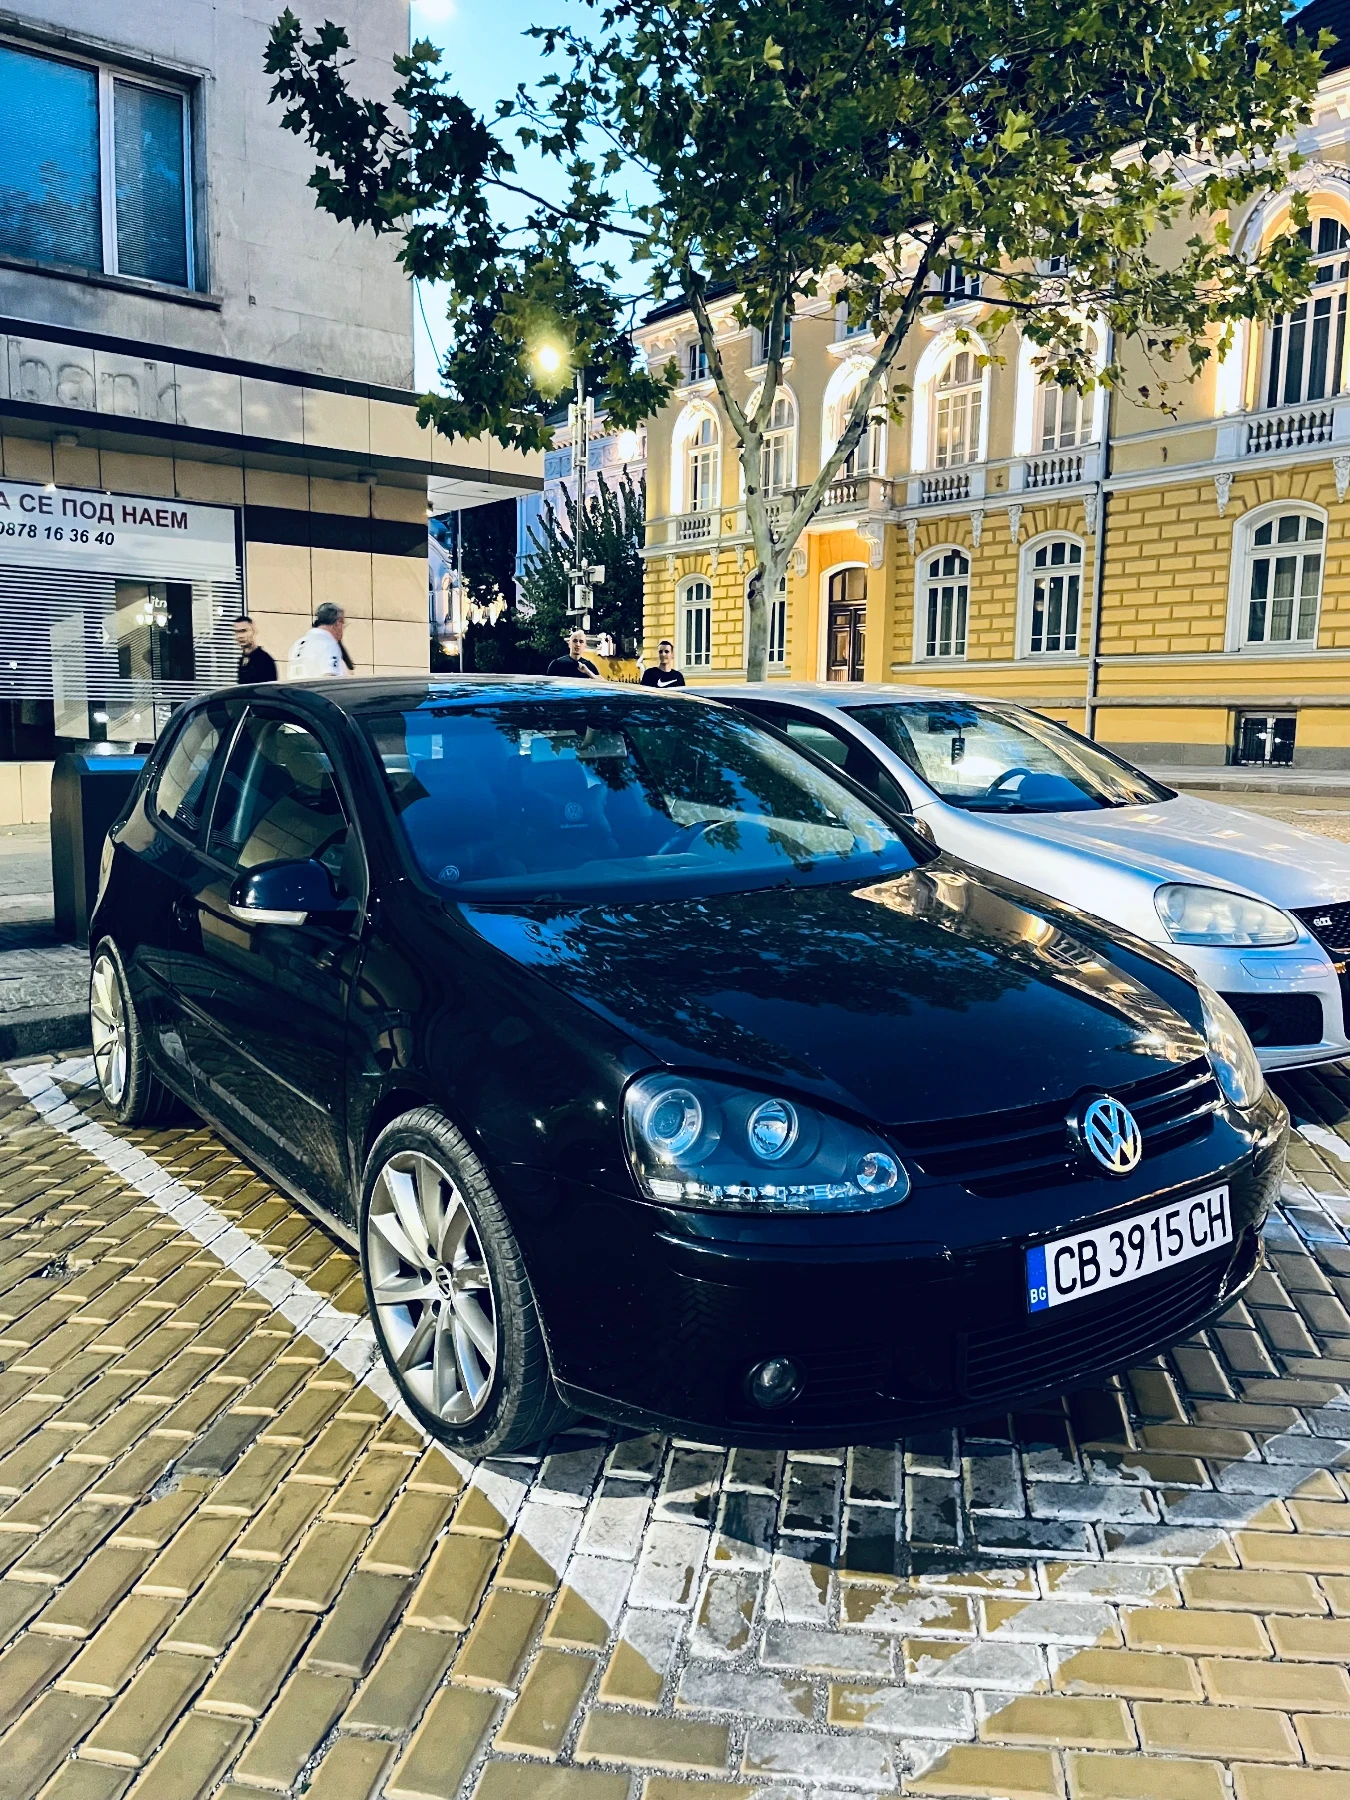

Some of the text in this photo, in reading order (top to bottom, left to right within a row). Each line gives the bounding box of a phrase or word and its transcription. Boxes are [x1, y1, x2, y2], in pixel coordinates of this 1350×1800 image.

[19, 493, 54, 516] СЕ
[62, 498, 115, 526] ПОД
[122, 504, 188, 530] НАЕМ
[44, 526, 64, 541] 16
[69, 528, 90, 543] 36
[94, 531, 115, 546] 40
[1054, 1193, 1227, 1295] CB 3915 CH
[1030, 1286, 1047, 1304] BG
